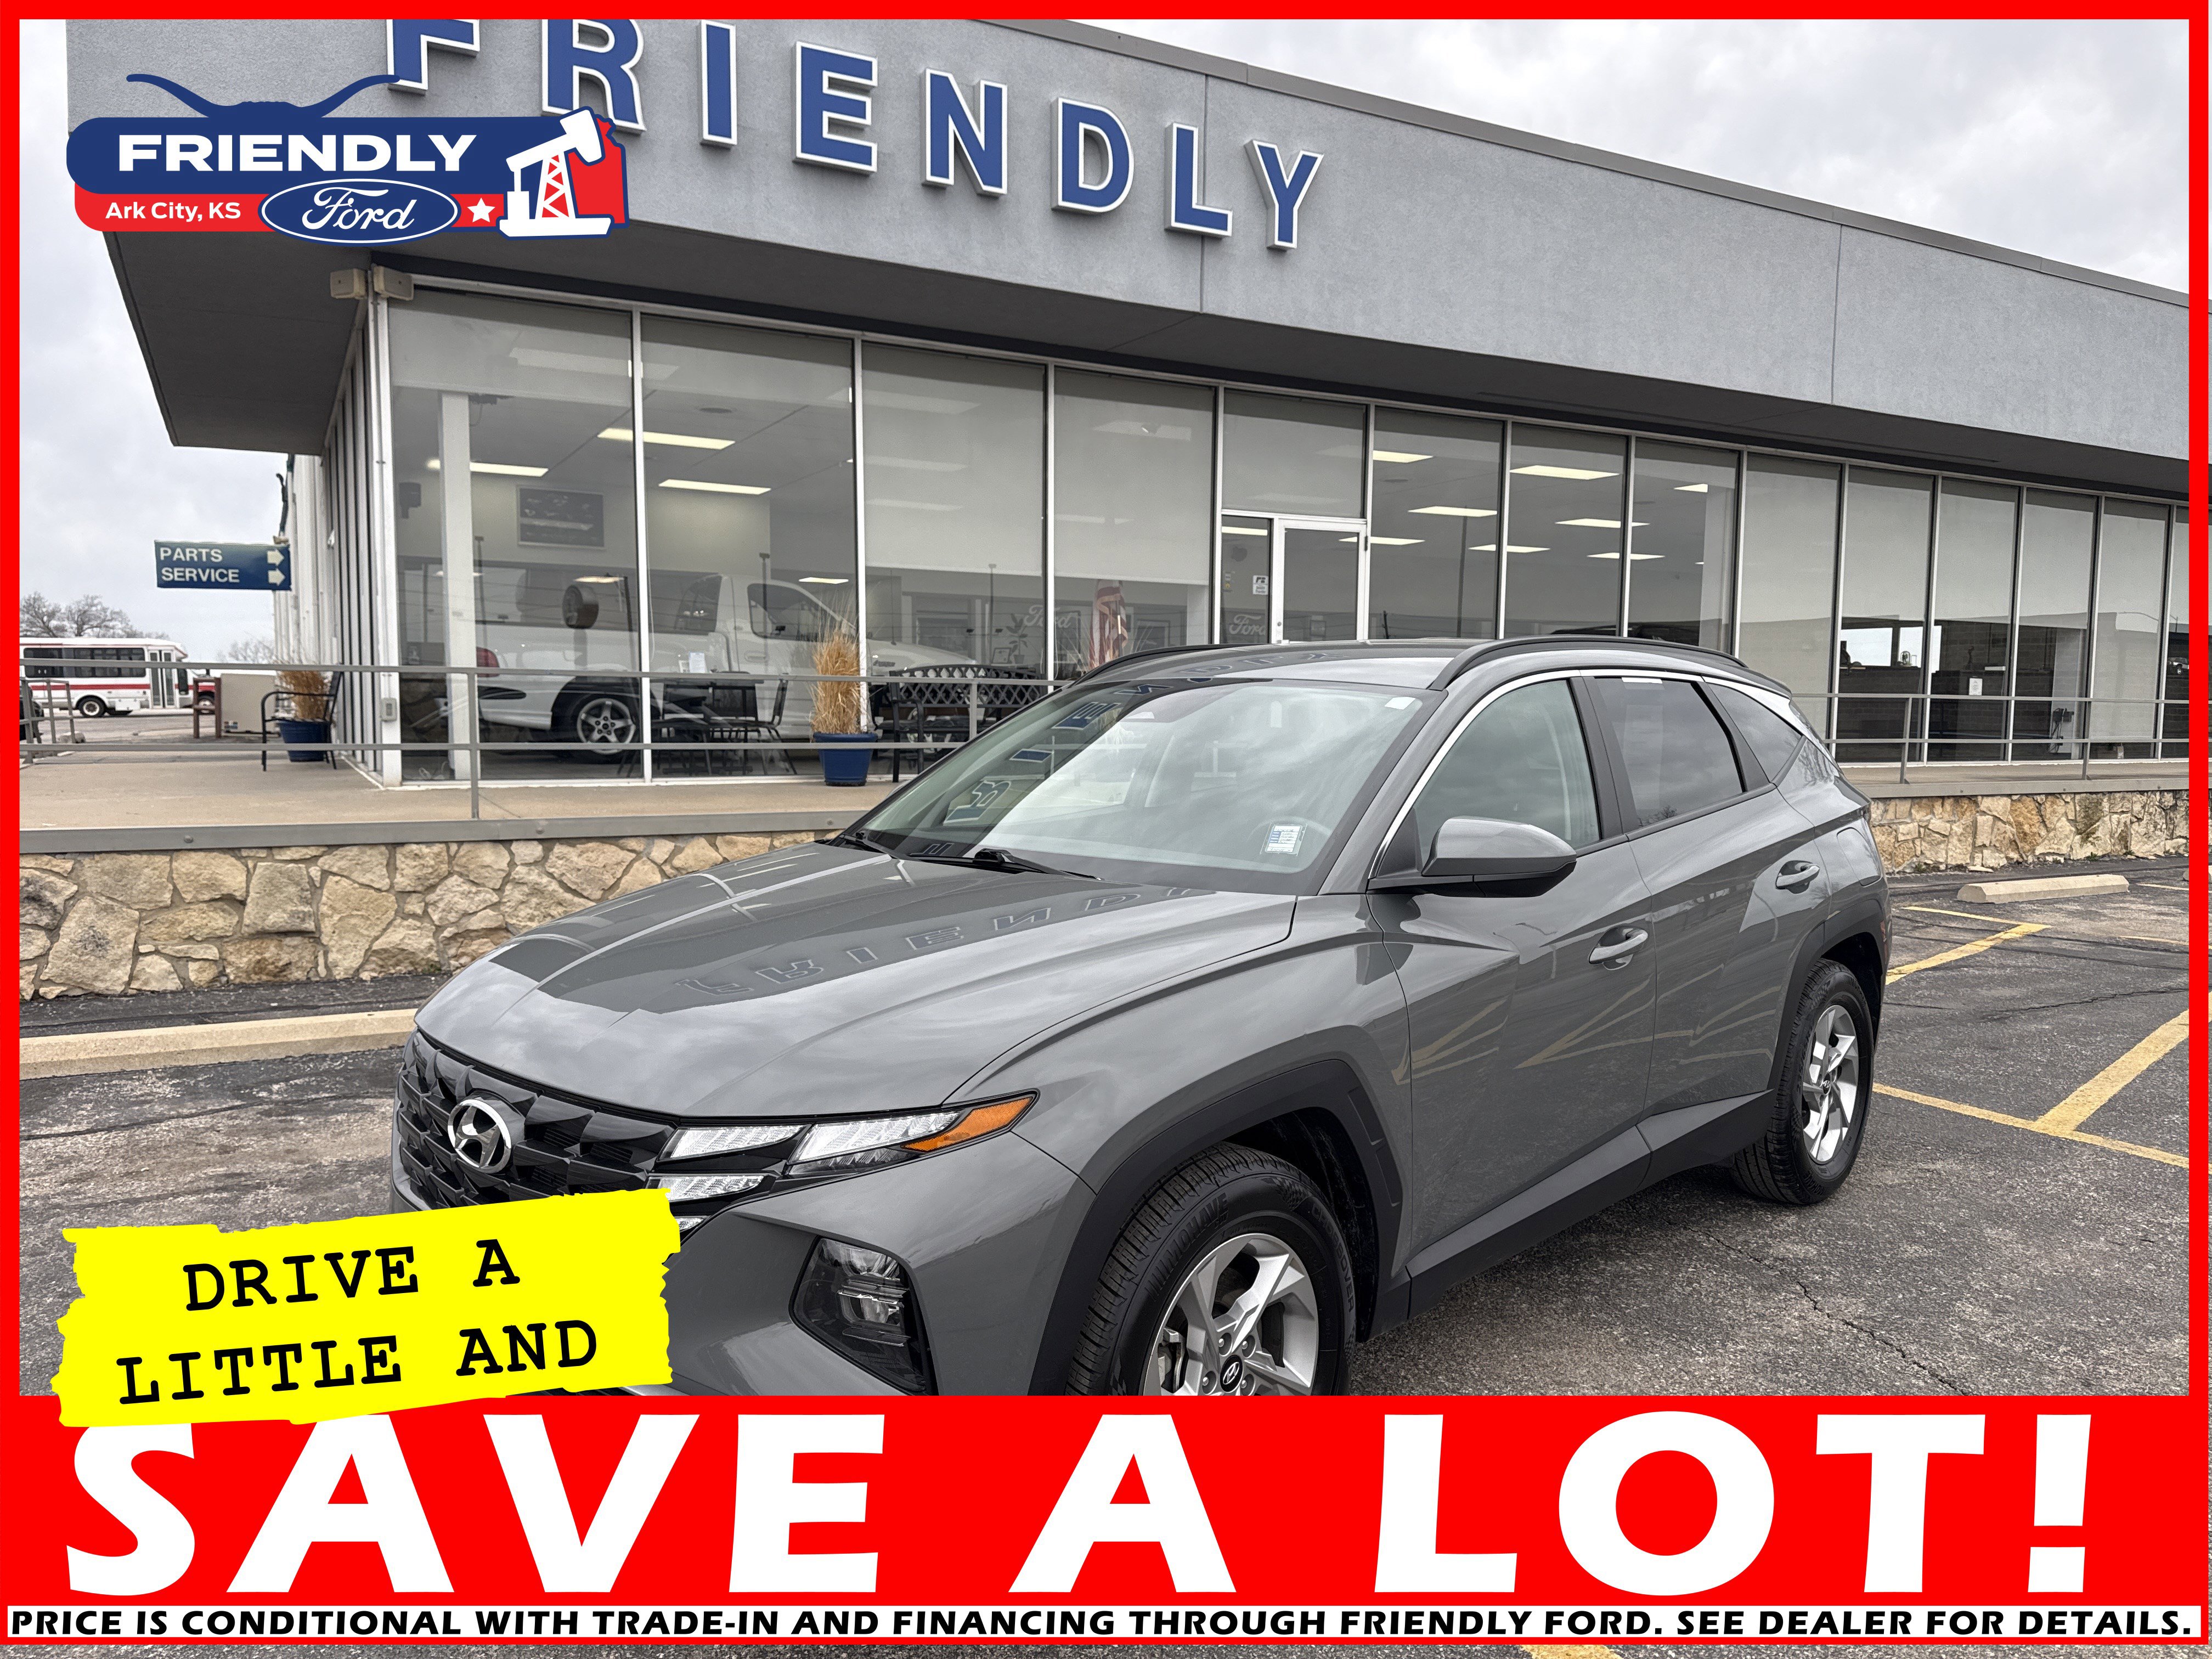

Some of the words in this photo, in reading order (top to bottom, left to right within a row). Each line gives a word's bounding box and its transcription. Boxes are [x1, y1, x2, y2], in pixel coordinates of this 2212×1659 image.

[386, 20, 1324, 251] FRIENDLY
[160, 548, 223, 562] PARTS
[161, 567, 240, 583] SERVICE
[1163, 1193, 1228, 1274] MOHAVE
